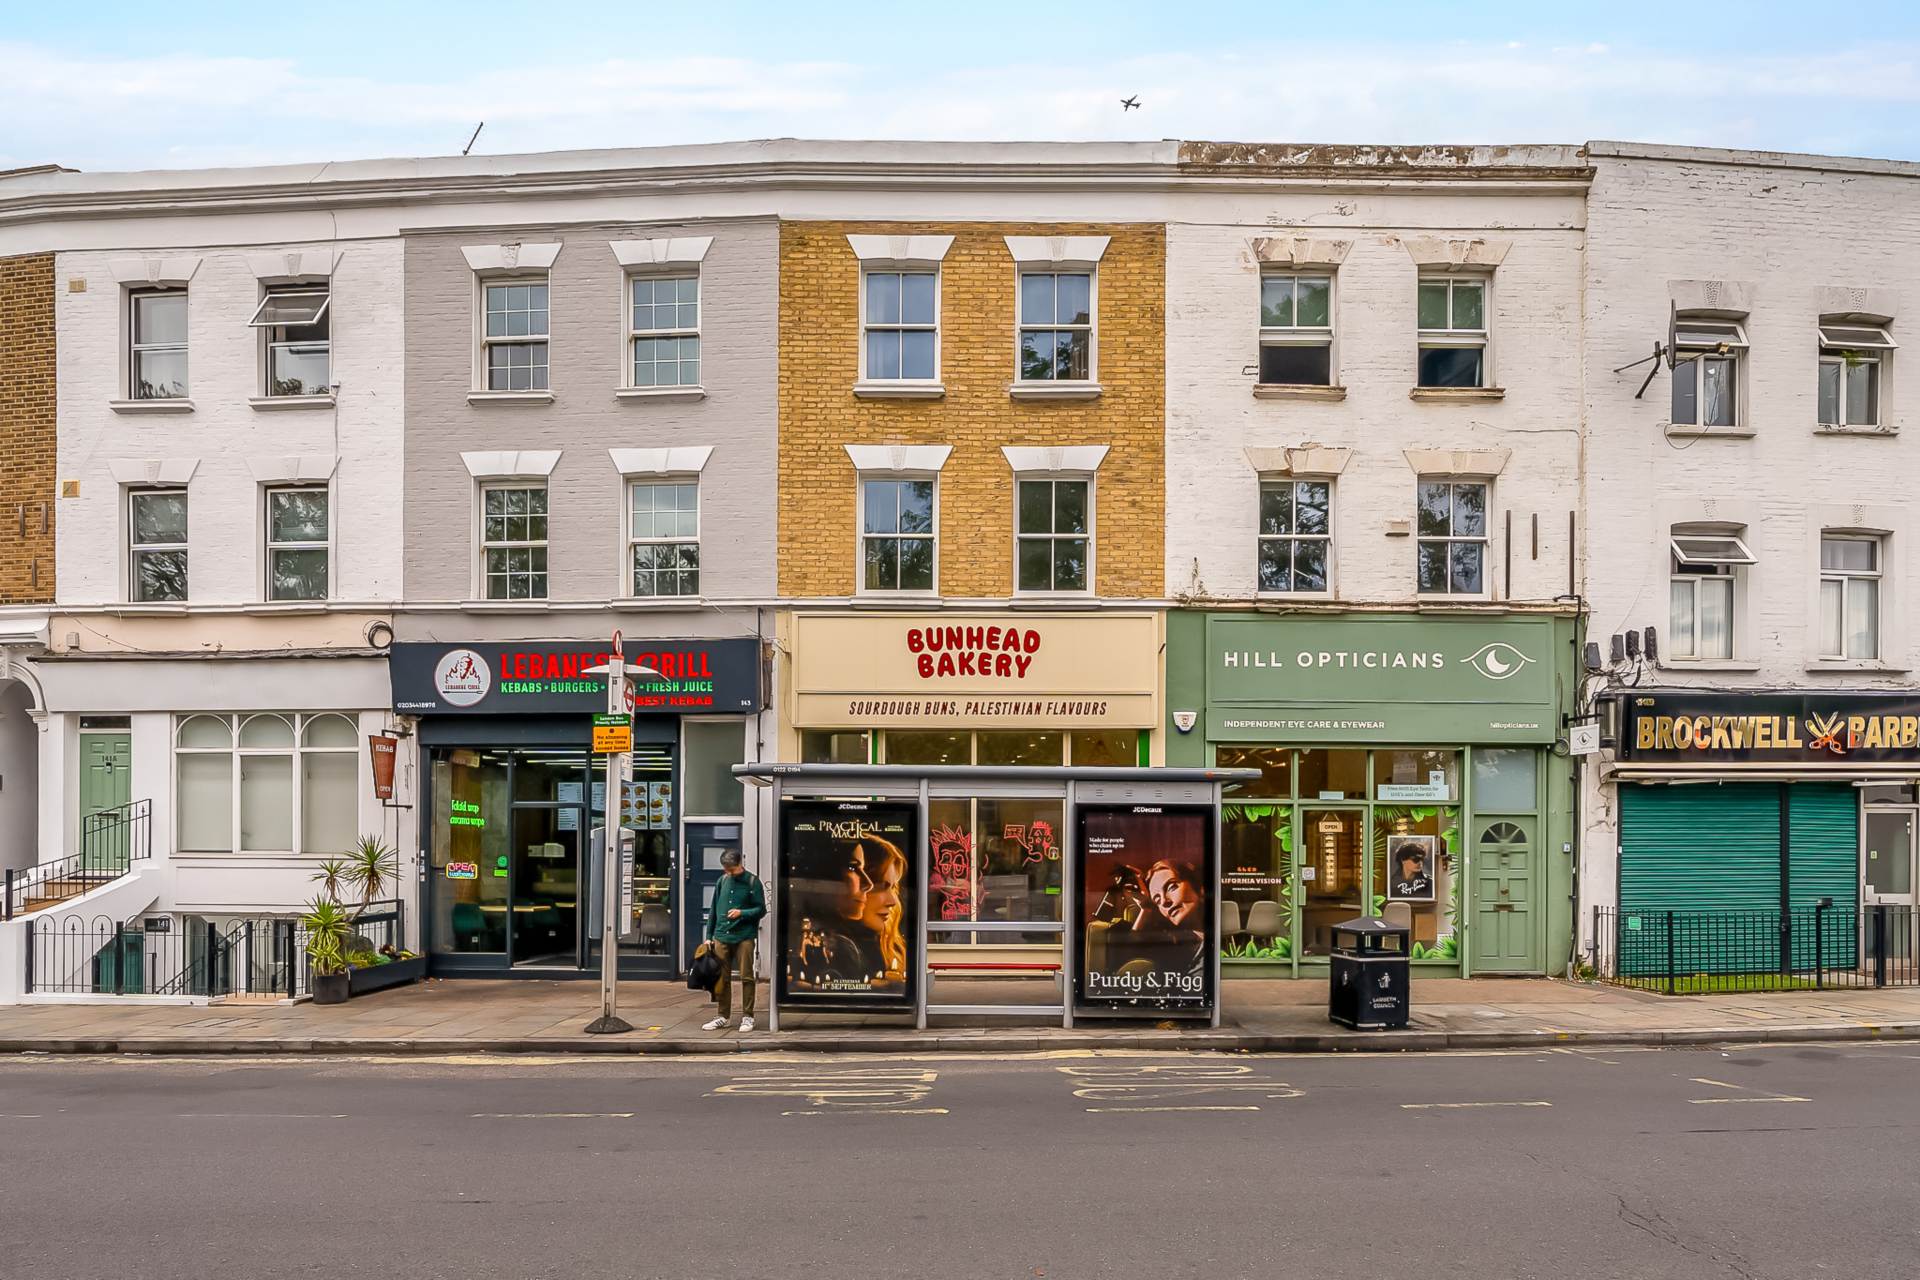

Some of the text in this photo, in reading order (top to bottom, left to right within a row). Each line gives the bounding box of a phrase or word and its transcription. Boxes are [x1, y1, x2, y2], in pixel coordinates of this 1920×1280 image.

[906, 626, 1041, 653] BUNHEAD
[917, 651, 1032, 678] BAKERY
[1224, 652, 1444, 668] HILL OPTICIANS
[501, 682, 542, 693] KEBABS
[550, 682, 599, 693] BURGERS
[646, 681, 680, 692] FRESH
[683, 681, 713, 692] JUICE
[849, 701, 1107, 717] SOURDOUGH BUNS, PALESTINIAN FLAVOURS
[1224, 720, 1286, 728] INDEPENDENT
[1287, 720, 1305, 728] EYE
[1341, 721, 1385, 729] EYEWEAR
[1636, 715, 1920, 749] BROCKWELL BARB
[375, 744, 394, 753] KEBAB
[819, 820, 882, 832] PRACTICAL
[831, 828, 868, 839] MAGIC
[448, 863, 475, 872] OPEN
[1397, 881, 1426, 895] Ray-Ban
[1088, 971, 1203, 992] Purdy & Figg
